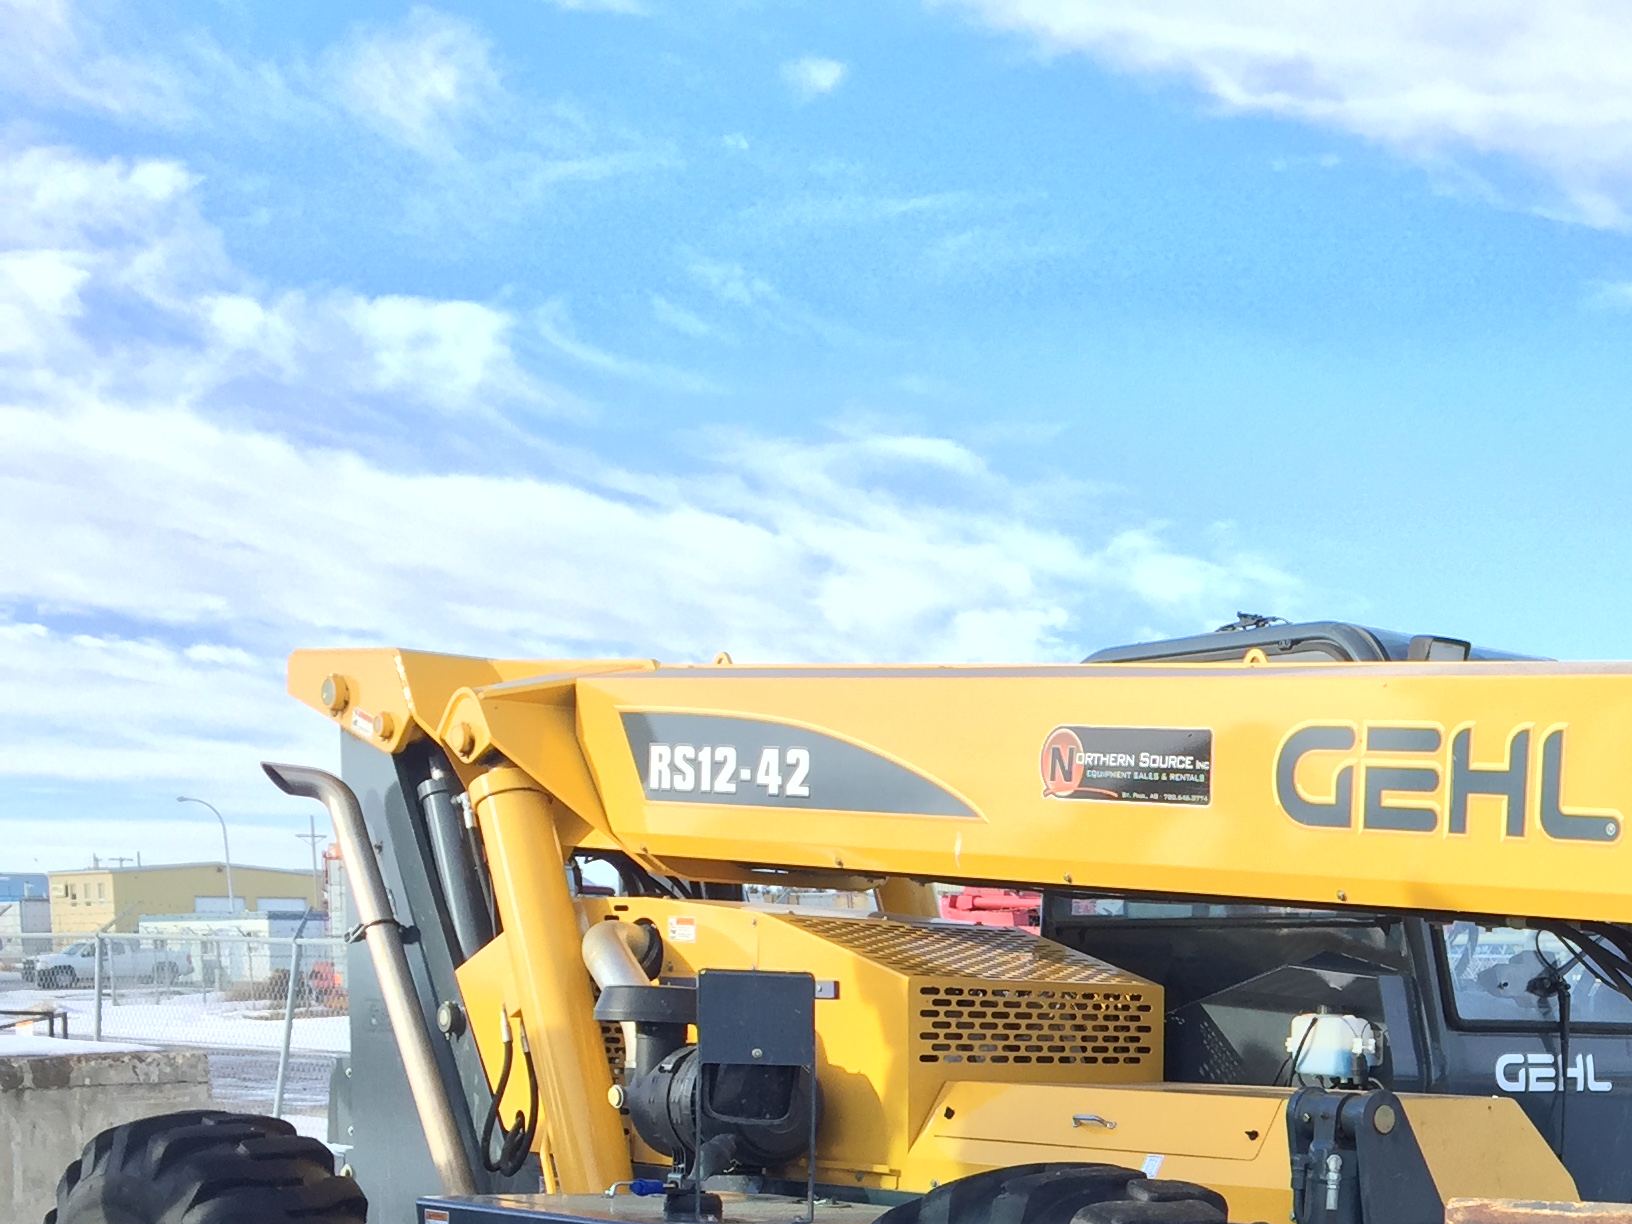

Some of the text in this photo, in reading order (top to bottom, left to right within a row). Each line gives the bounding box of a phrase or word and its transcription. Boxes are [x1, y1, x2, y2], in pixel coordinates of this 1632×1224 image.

[649, 743, 811, 798] RS12-42
[1086, 769, 1132, 779] EQUIPMENT
[1169, 773, 1205, 782] RENTALS
[1275, 725, 1622, 842] GEHL
[1496, 1053, 1613, 1092] GEHL
